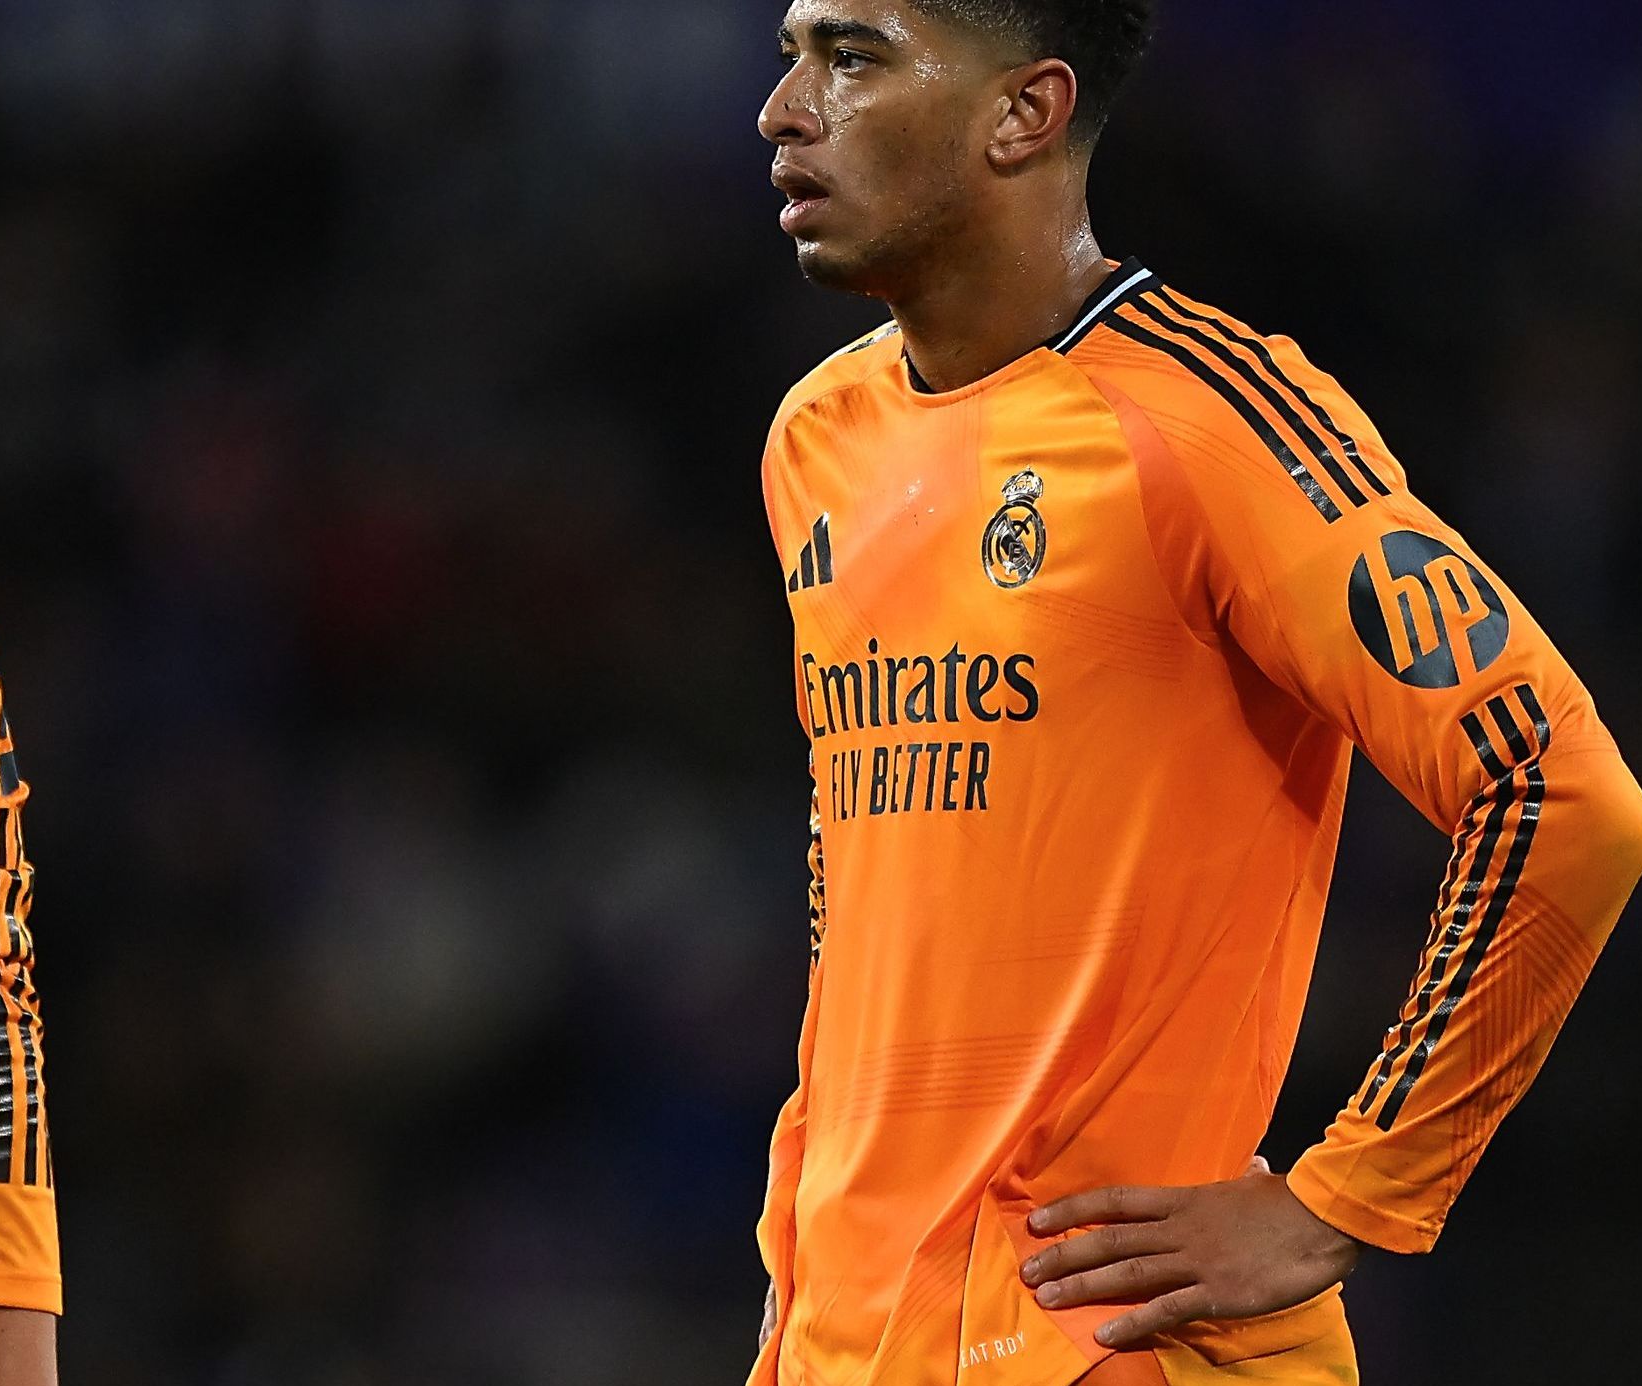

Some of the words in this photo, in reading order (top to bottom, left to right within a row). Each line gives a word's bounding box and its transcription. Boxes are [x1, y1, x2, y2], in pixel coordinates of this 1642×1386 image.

[1358, 533, 1492, 687] hp
[802, 637, 1040, 739] Emirates
[832, 749, 862, 823] FLY
[868, 741, 992, 816] BETTER
[960, 1331, 1026, 1369] EAT.RDY
